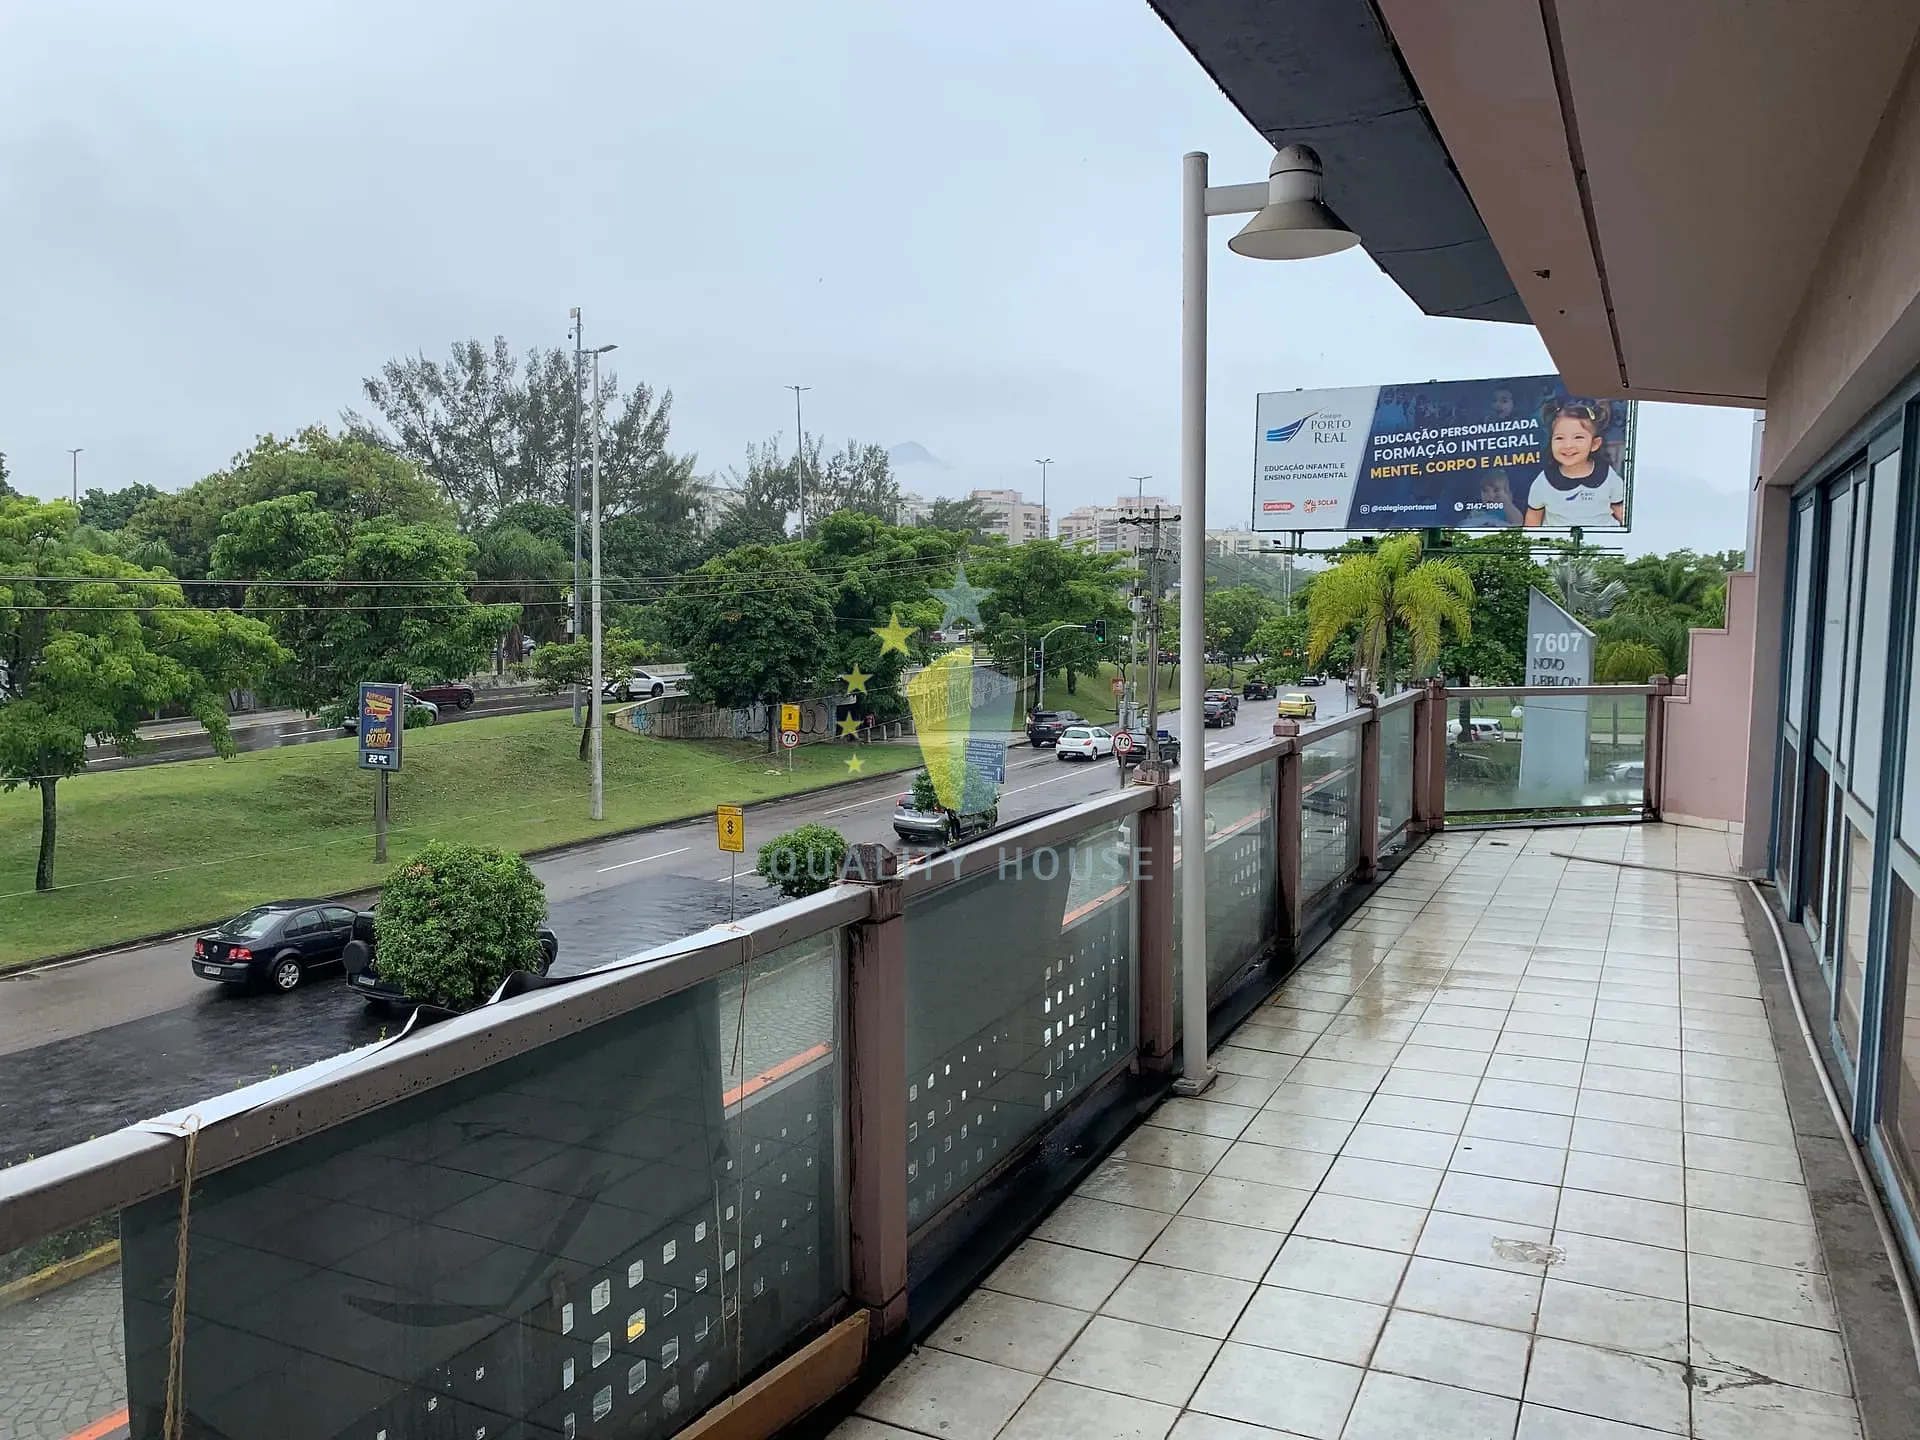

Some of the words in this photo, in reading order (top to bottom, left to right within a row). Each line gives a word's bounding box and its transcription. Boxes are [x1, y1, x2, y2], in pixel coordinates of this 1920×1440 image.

[1311, 419, 1351, 430] PORTO
[1374, 428, 1439, 446] EDUCAÇÃO
[1440, 418, 1538, 437] PERSONALIZADA
[1314, 432, 1347, 444] REAL
[1374, 440, 1457, 462] FORMAÇÃO
[1461, 433, 1539, 453] INTEGRAL
[1264, 463, 1304, 472] EDUCAÇÃO
[1370, 463, 1422, 479] MENTE,
[1426, 458, 1477, 473] CORPO
[1480, 457, 1490, 468] E
[1493, 451, 1541, 467] ALMA!
[1292, 472, 1348, 480] FUNDAMENTAL
[1532, 632, 1583, 653] 7607
[1533, 657, 1565, 671] NOVO
[366, 733, 376, 743] DO
[785, 733, 797, 742] 70
[1117, 737, 1130, 746] 70
